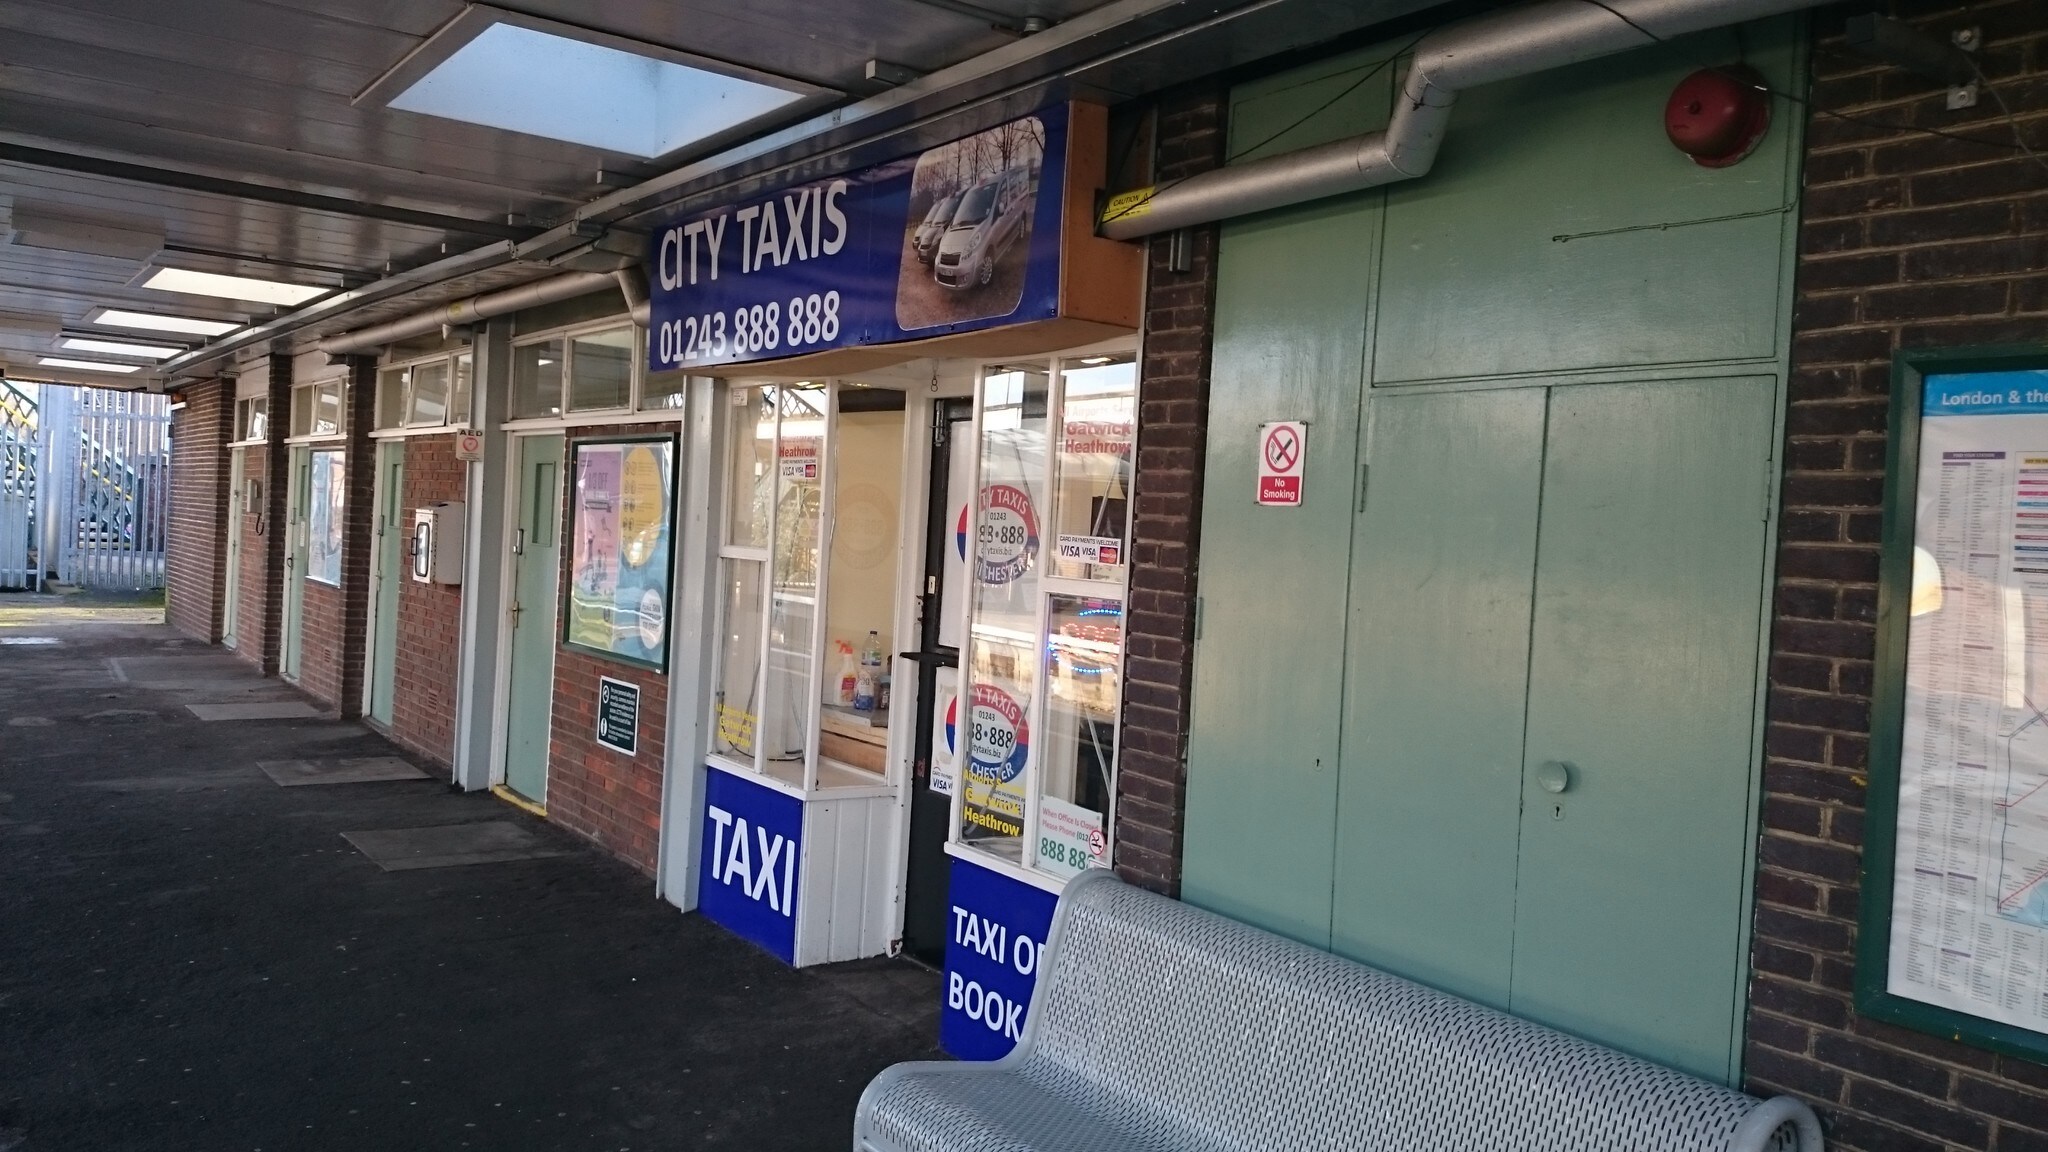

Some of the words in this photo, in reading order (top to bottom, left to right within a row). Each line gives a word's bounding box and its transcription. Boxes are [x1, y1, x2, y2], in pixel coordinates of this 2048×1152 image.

[1113, 194, 1139, 207] CAUTION
[659, 214, 727, 292] CITY
[736, 179, 847, 274] TAXIS
[660, 311, 727, 364] 01243
[734, 301, 780, 354] 888
[787, 290, 840, 346] 888
[1942, 390, 2003, 406] London
[2008, 390, 2021, 404] &
[460, 429, 483, 437] AED
[1066, 420, 1131, 436] Gatwick
[779, 446, 817, 458] Heathrow
[1065, 439, 1131, 453] Heathrow
[1274, 478, 1285, 487] No
[997, 488, 1028, 515] TAXIS
[1263, 489, 1295, 501] Smoking
[990, 512, 1007, 521] 01243
[1060, 545, 1080, 557] VISA
[1082, 547, 1096, 556] VISA
[986, 689, 1017, 720] TAXIS
[978, 710, 996, 722] 01243
[933, 778, 947, 790] VISA
[964, 806, 1020, 837] Heathrow
[1042, 807, 1057, 818] When
[1058, 813, 1074, 825] Office
[1042, 819, 1058, 831] Please
[1059, 825, 1076, 837] Phone
[1041, 837, 1065, 863] 888
[708, 805, 796, 917] TAXI
[952, 905, 1006, 964] TAXI
[948, 970, 1023, 1043] BOOK
